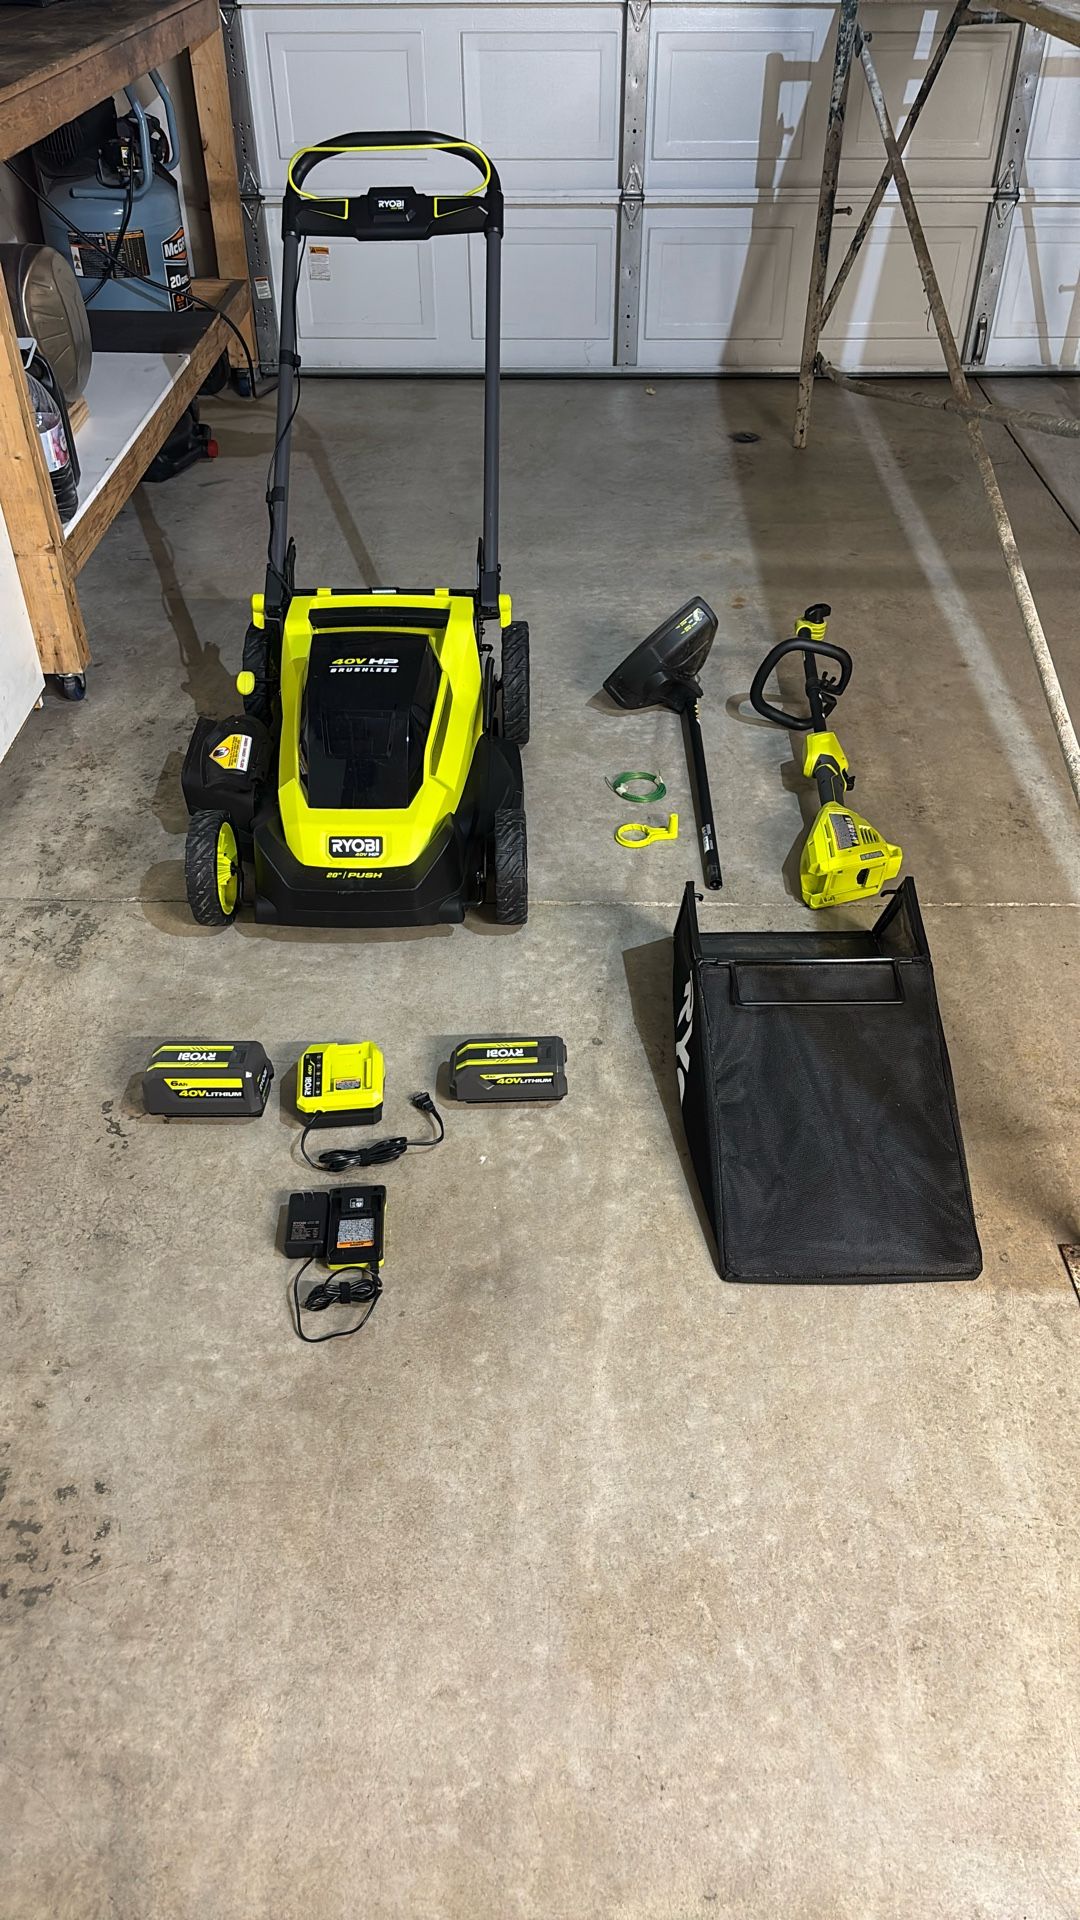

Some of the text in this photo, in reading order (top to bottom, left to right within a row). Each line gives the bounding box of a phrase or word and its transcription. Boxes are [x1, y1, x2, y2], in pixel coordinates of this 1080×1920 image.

[378, 200, 404, 208] RYOBI
[331, 838, 380, 853] RYOBI
[177, 1052, 217, 1061] RYOBI
[486, 1048, 525, 1058] RYOBI
[496, 1077, 521, 1085] 40V
[304, 1076, 313, 1096] RYOBI
